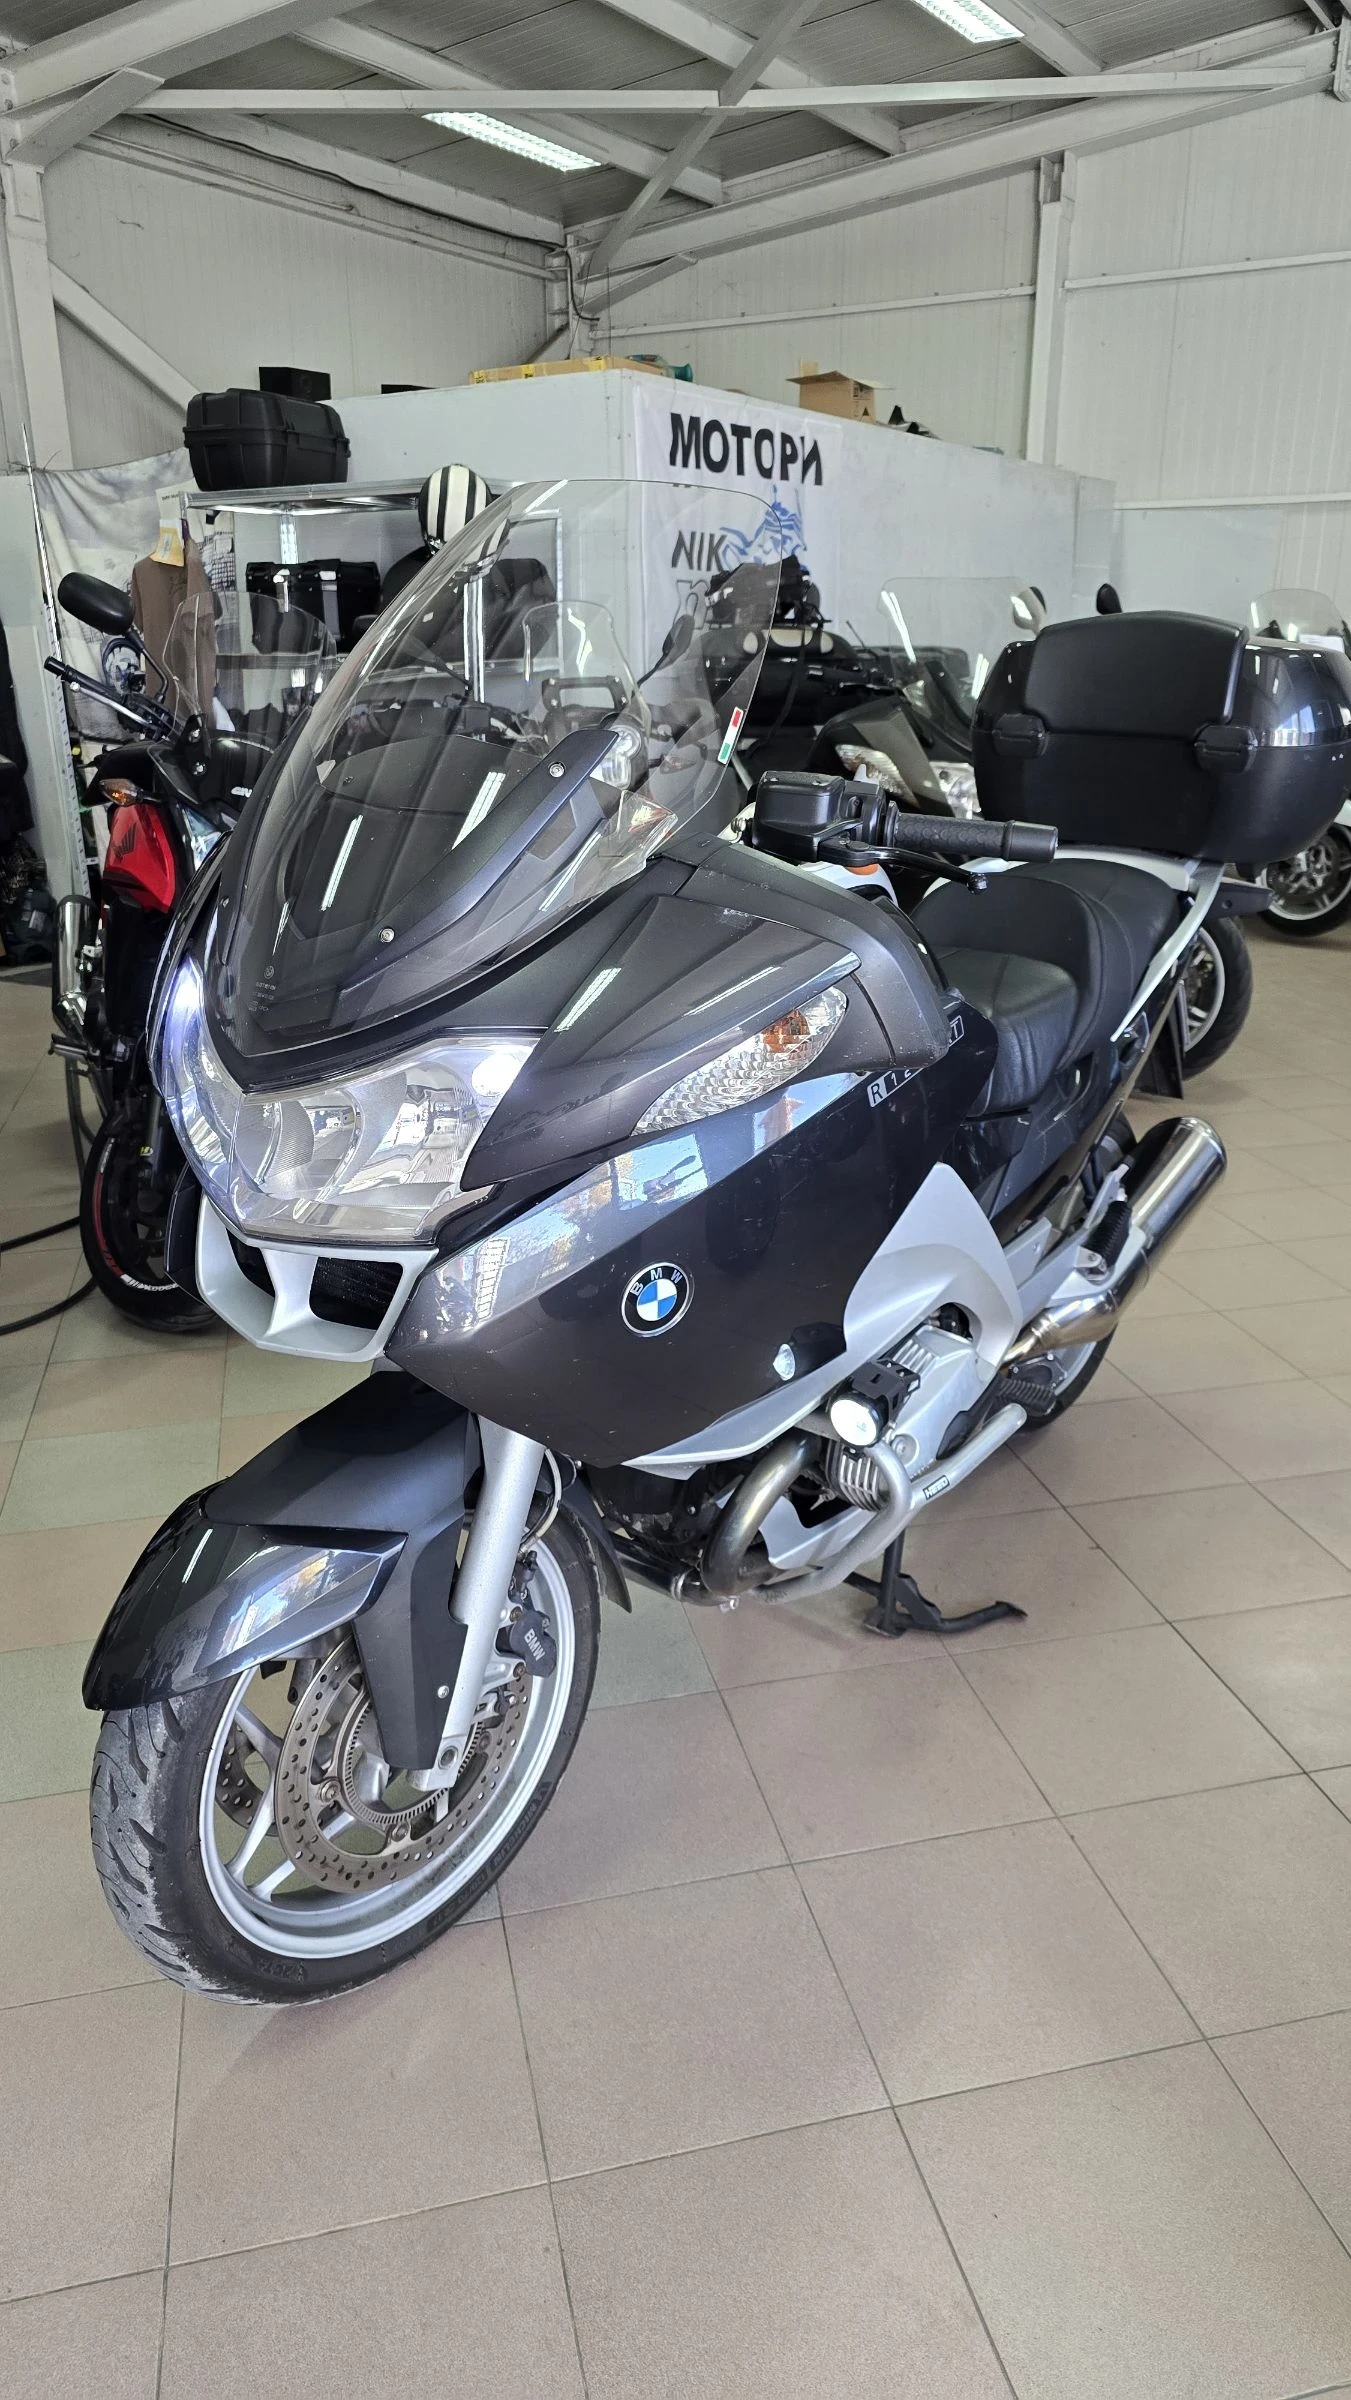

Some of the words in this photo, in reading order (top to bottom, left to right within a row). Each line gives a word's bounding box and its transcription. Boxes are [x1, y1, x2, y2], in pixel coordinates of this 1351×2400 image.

[669, 412, 823, 486] МОТОРИ
[870, 1082, 884, 1104] R
[630, 1267, 683, 1296] BMW
[524, 1628, 546, 1661] BMW
